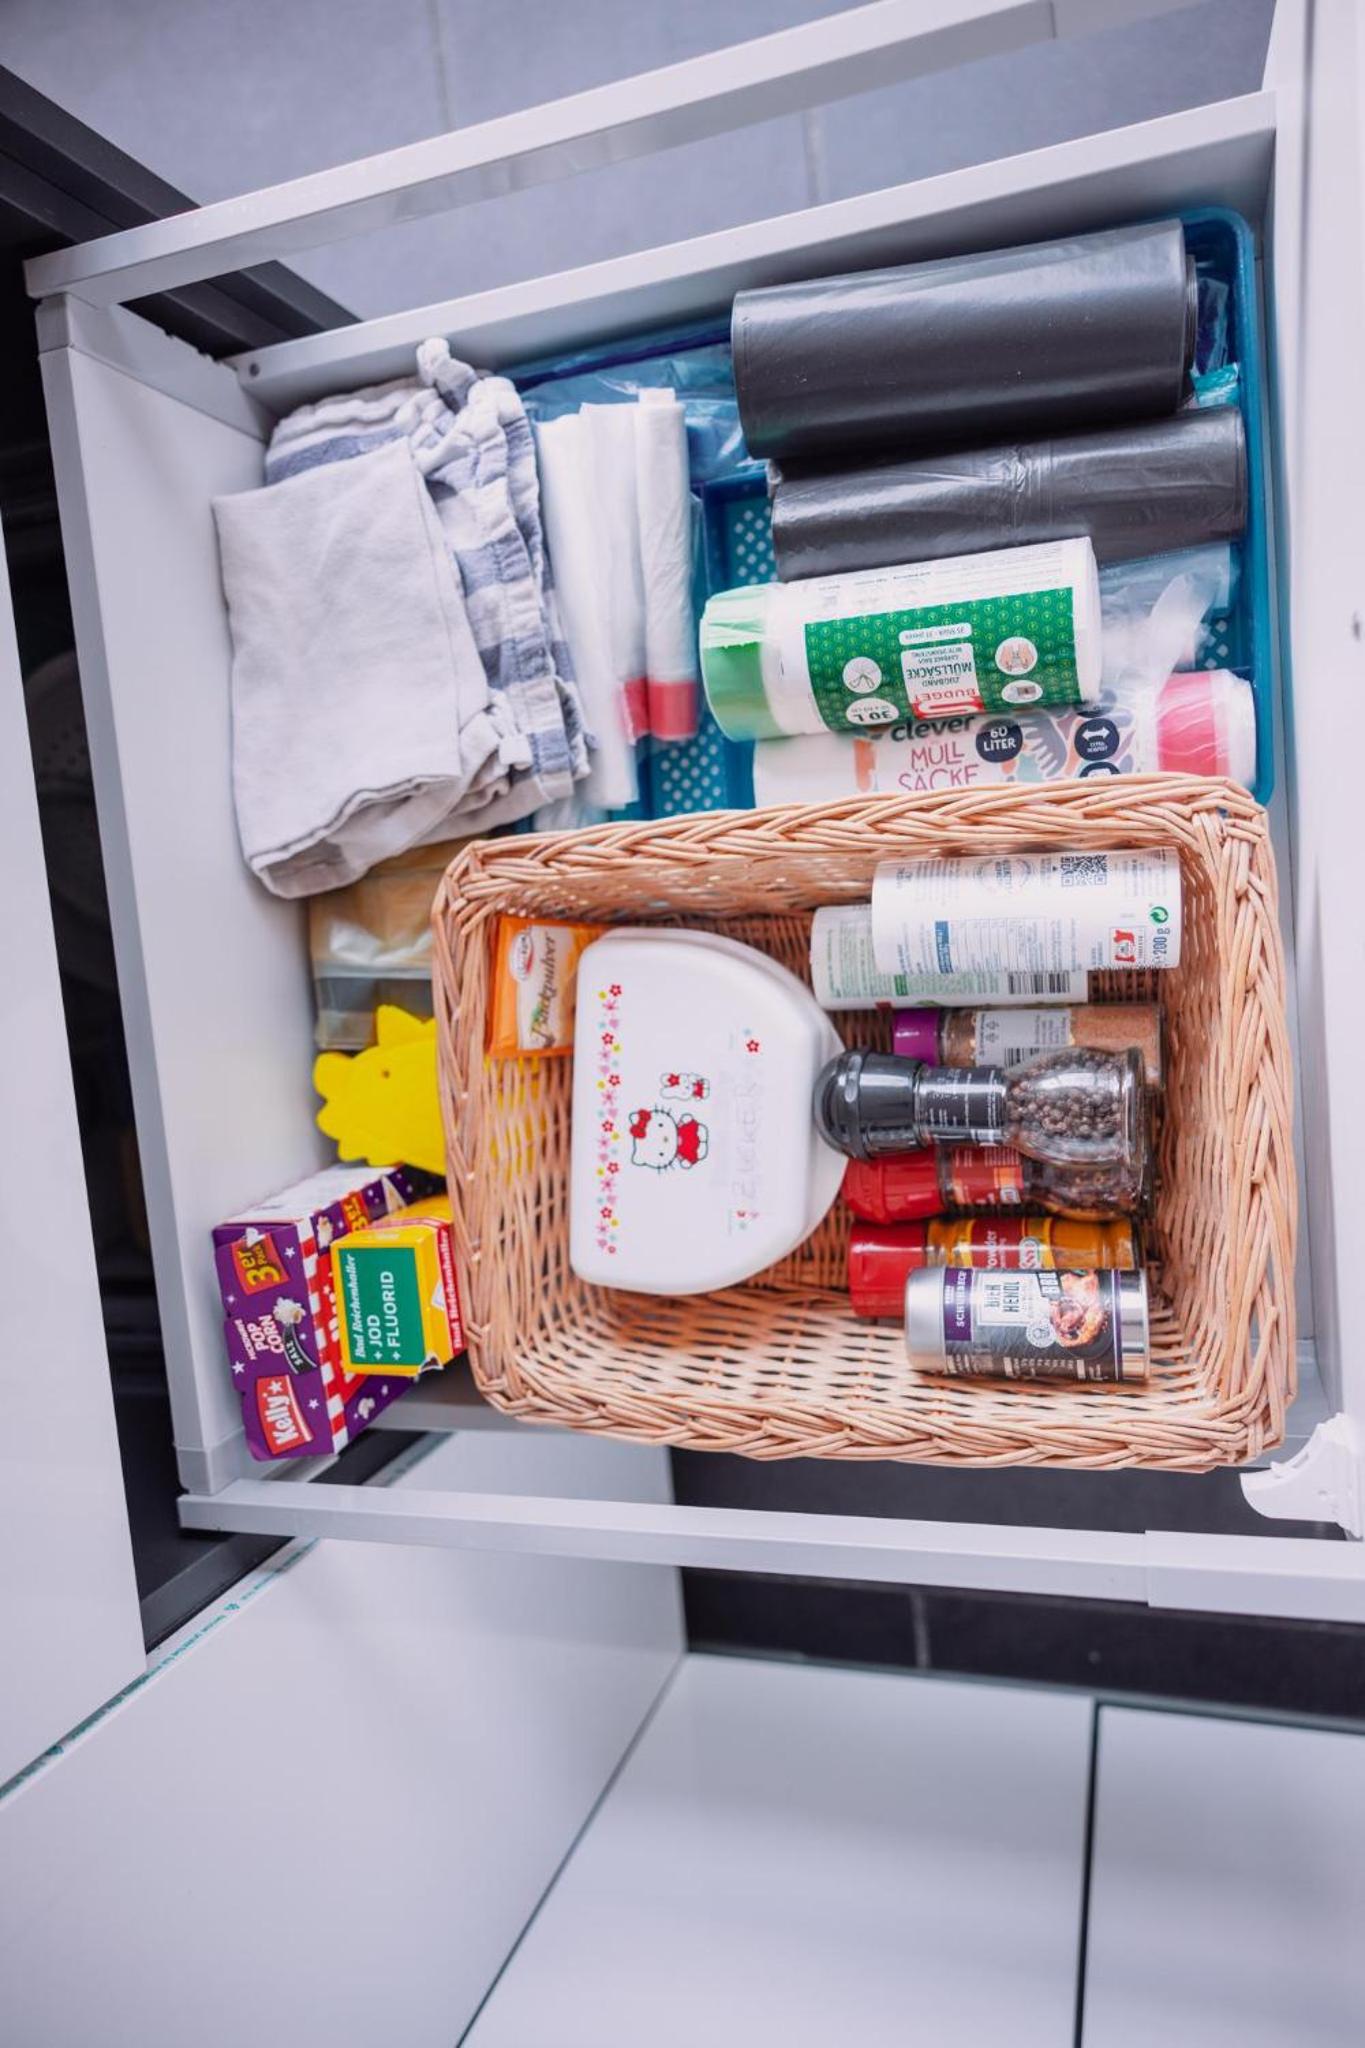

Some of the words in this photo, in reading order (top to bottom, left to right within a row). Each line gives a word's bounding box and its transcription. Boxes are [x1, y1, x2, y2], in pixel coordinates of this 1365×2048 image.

[906, 661, 973, 680] MÜLLSÄCKE
[914, 687, 977, 701] BUDGET
[868, 711, 894, 721] 30
[891, 715, 977, 742] clever
[990, 726, 1008, 738] 60
[345, 1253, 364, 1332] Reichenhaller
[380, 1271, 401, 1347] FLUORID
[247, 1322, 270, 1352] POP
[258, 1314, 284, 1354] CORN
[367, 1315, 383, 1347] JOD
[354, 1334, 366, 1358] Bad
